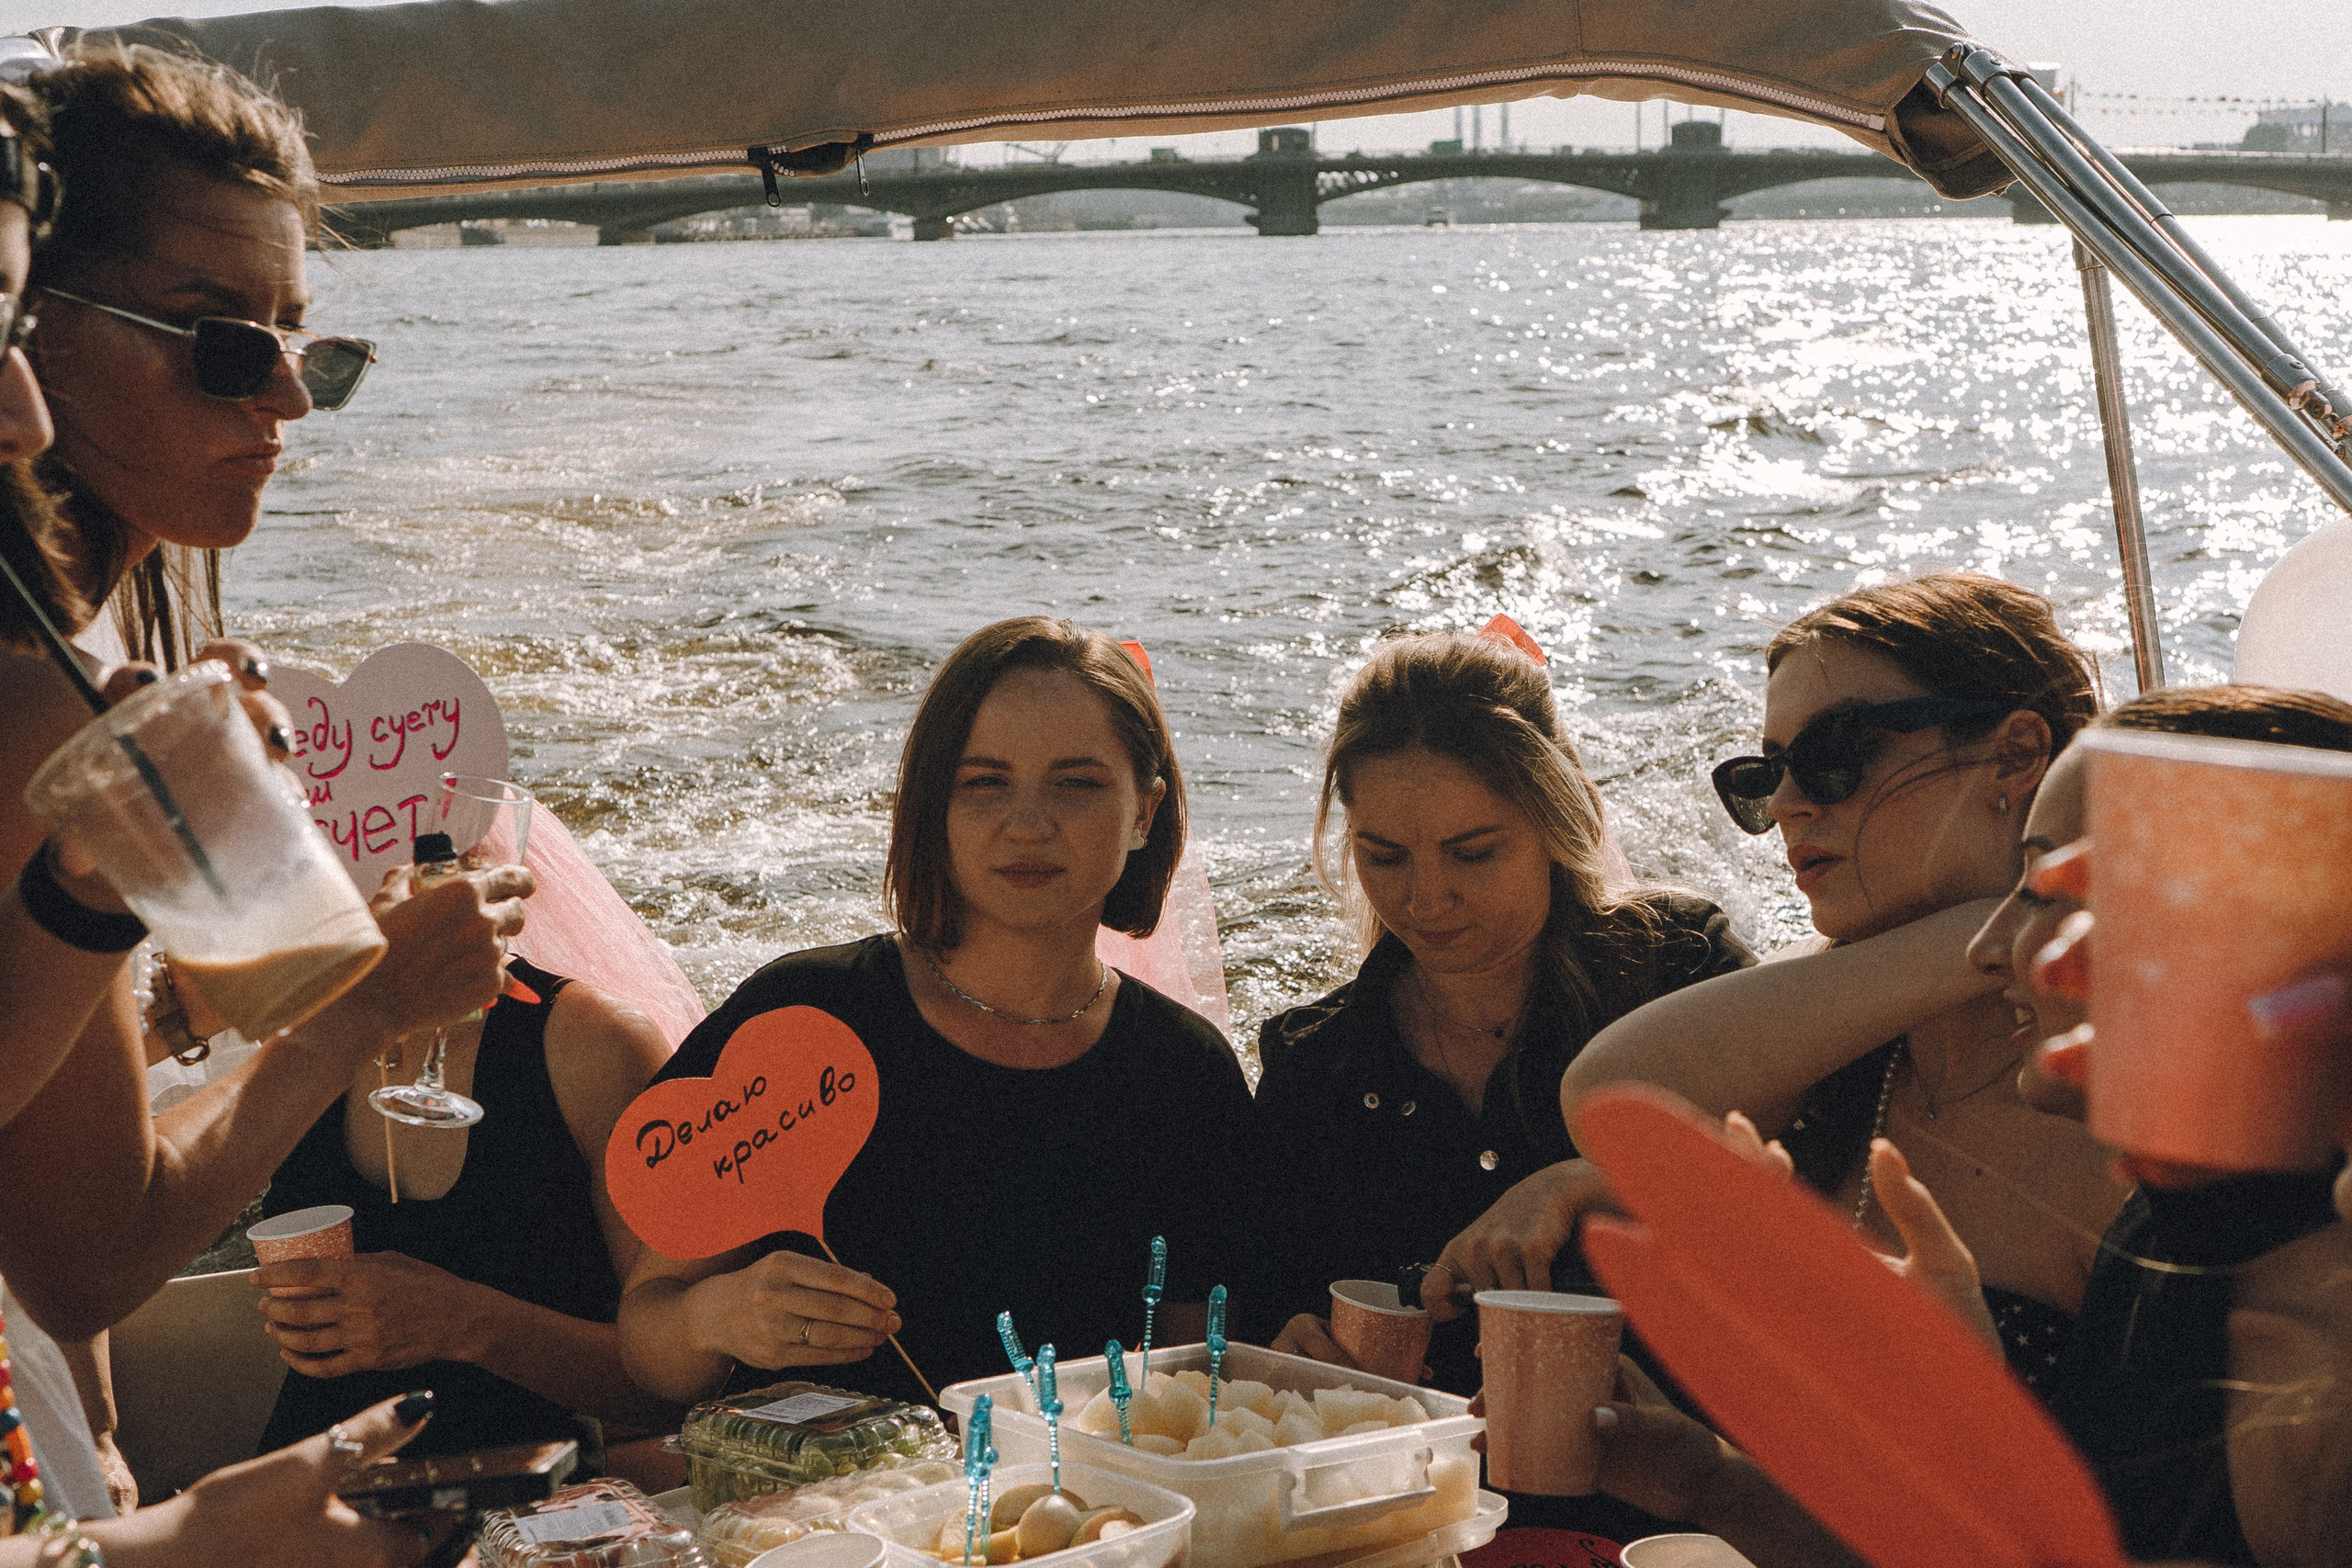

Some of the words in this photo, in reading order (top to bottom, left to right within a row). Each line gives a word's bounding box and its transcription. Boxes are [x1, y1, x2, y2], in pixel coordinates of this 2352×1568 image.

[293, 696, 353, 780] еду
[368, 697, 459, 770] суету
[636, 1076, 767, 1168] Делаю
[713, 1066, 856, 1184] красиво
